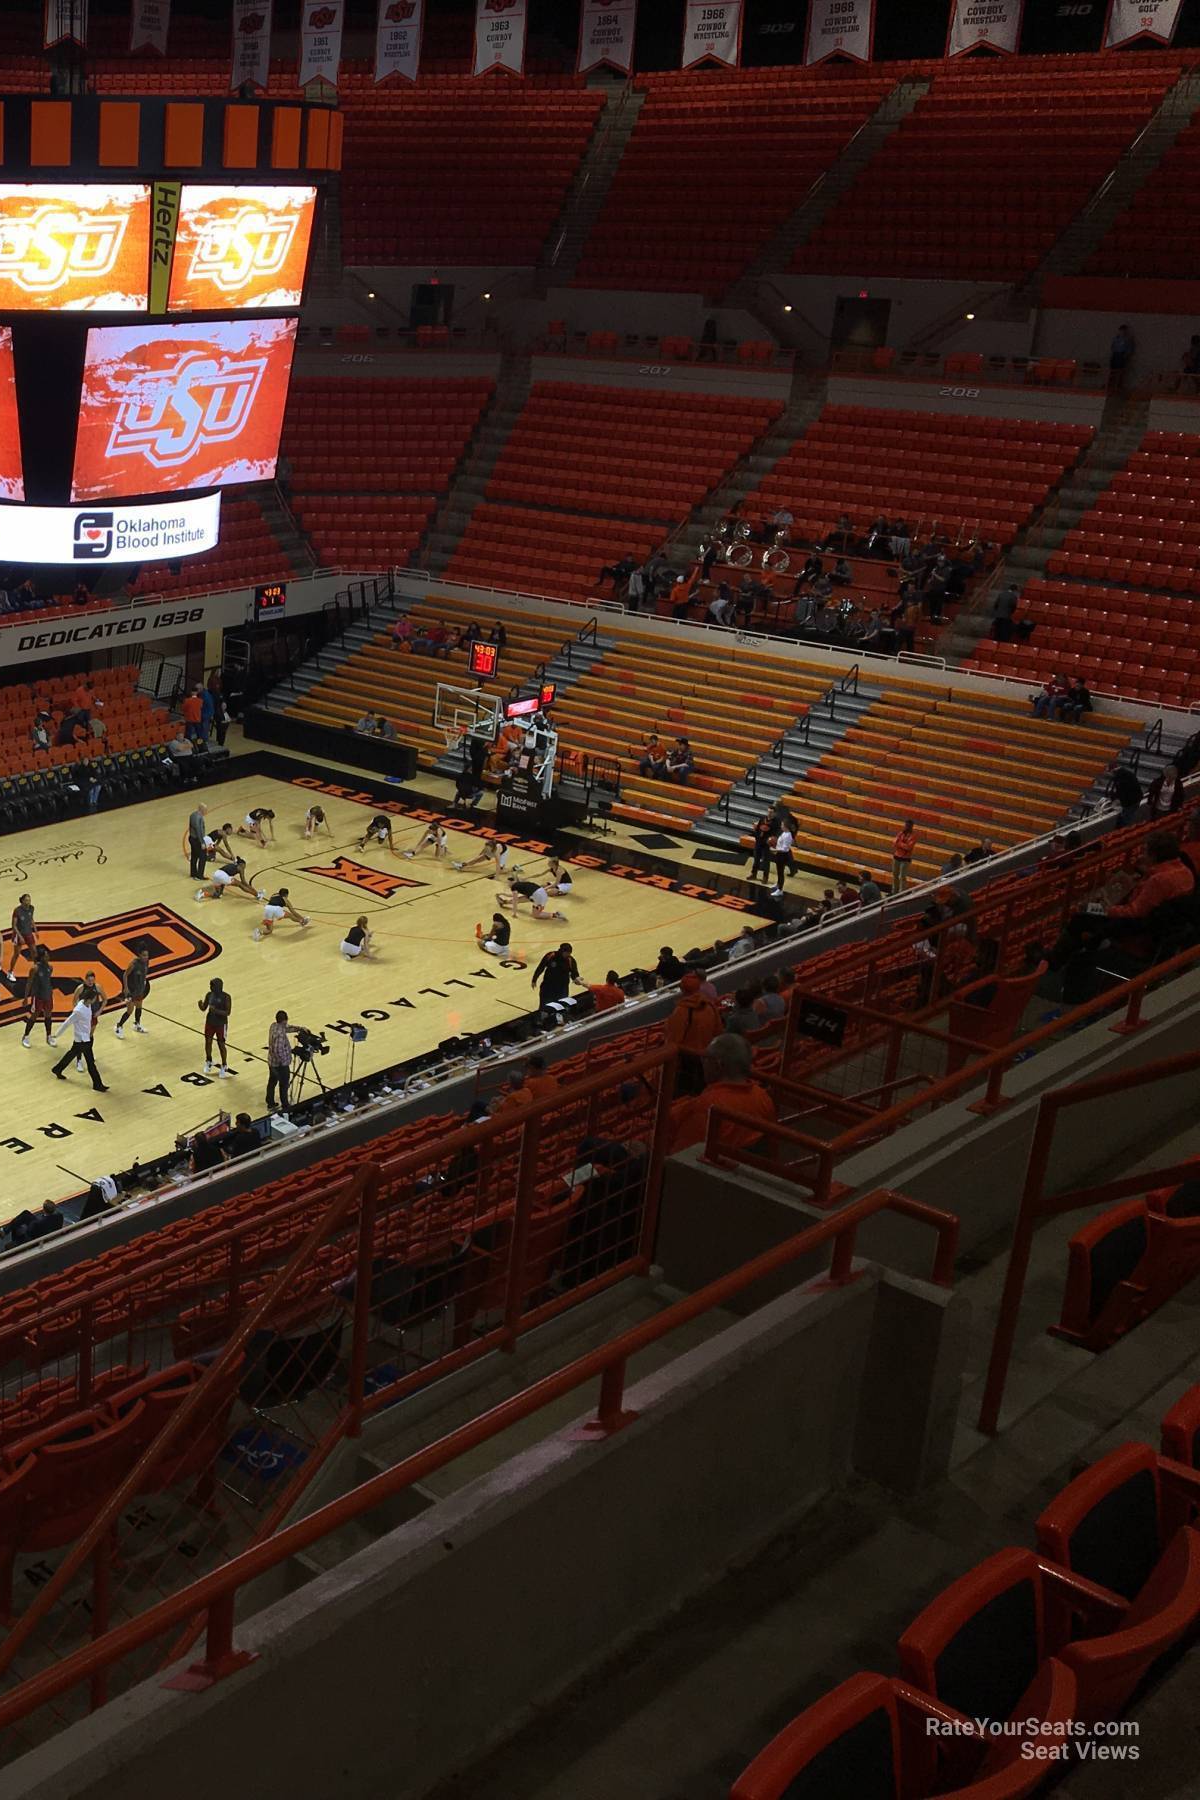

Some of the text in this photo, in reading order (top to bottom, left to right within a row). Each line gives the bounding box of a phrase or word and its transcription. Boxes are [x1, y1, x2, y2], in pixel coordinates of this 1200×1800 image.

[967, 5, 1004, 15] COWBOY
[697, 22, 727, 31] COWBOY
[824, 16, 858, 26] COWBOY
[963, 15, 1007, 25] WRESTLING
[693, 31, 729, 40] WRESTLING
[821, 25, 860, 35] WRESTLING
[155, 185, 177, 267] Hertz
[188, 208, 301, 291] OSU
[940, 386, 980, 398] 208
[105, 353, 268, 469] OSU
[117, 516, 185, 534] Oklahoma
[117, 528, 205, 550] Blood Institute
[17, 616, 146, 651] DEDICATED
[153, 608, 205, 629] 1938
[474, 645, 495, 657] 43:03
[291, 776, 757, 911] OKLAHOMA STATE
[804, 1012, 839, 1032] 214
[23, 1560, 55, 1588] AT
